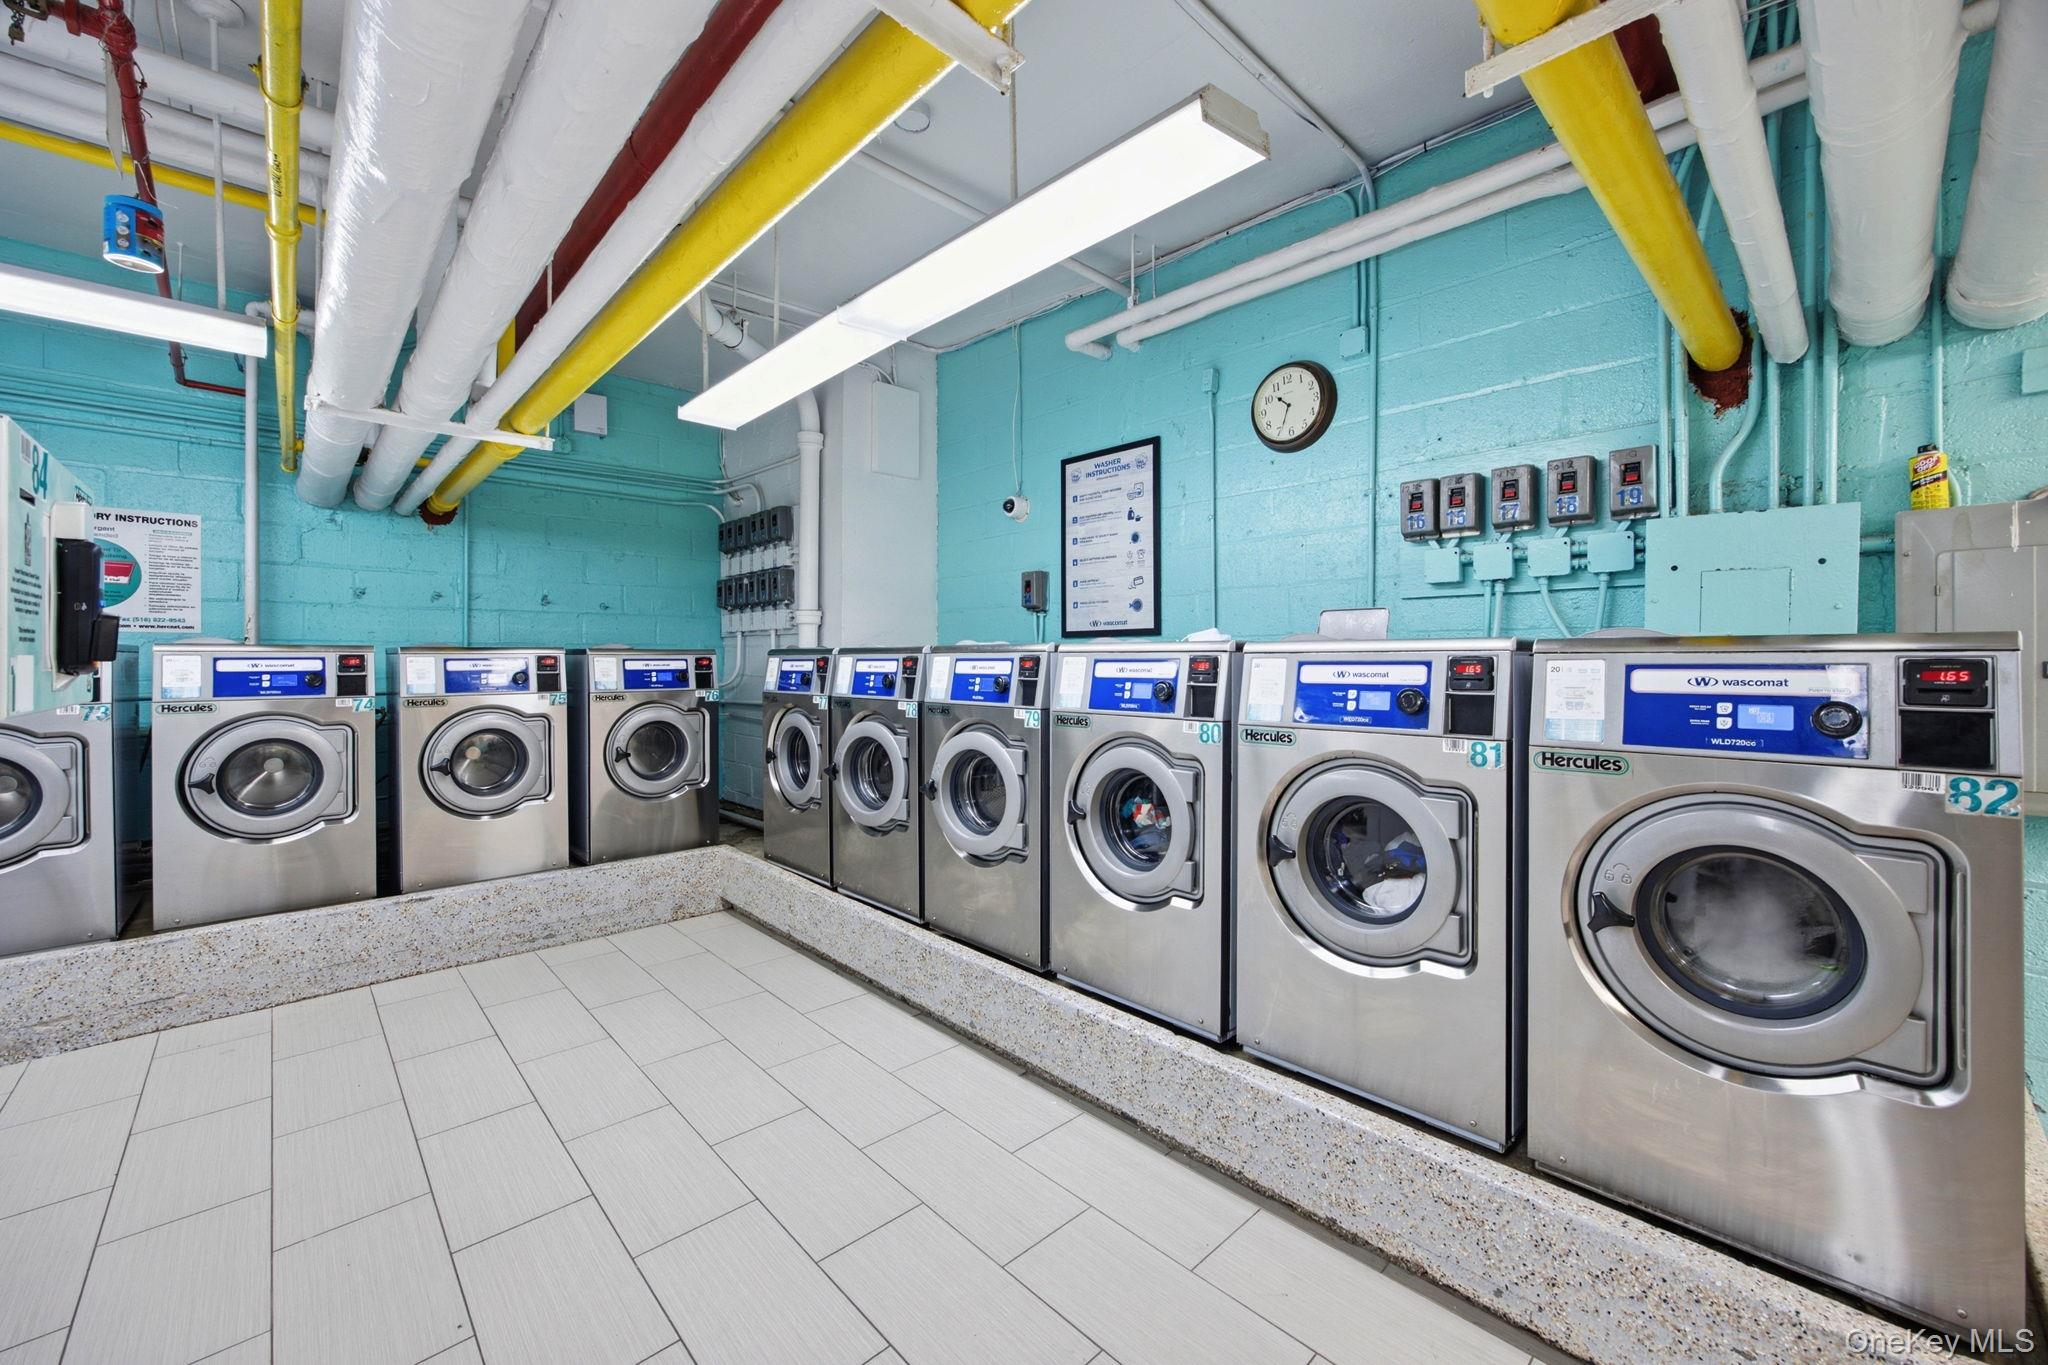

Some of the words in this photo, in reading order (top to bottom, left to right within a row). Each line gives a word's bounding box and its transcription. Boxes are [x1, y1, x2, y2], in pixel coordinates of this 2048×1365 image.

[1282, 373, 1293, 386] 12
[1299, 374, 1303, 383] 1
[1272, 382, 1280, 392] 11
[1308, 380, 1315, 391] 2
[1264, 395, 1274, 405] 10
[1313, 391, 1320, 402] 3
[1260, 409, 1267, 419] 9
[1309, 407, 1316, 416] 4
[1265, 420, 1272, 430] 8
[1301, 418, 1308, 429] 5
[1276, 426, 1282, 437] 7
[1288, 426, 1295, 437] 6
[1093, 457, 1122, 469] WASHER
[32, 444, 48, 499] 84
[1085, 463, 1132, 479] INSTRUCTIONS
[1616, 486, 1643, 507] 19
[1554, 495, 1578, 515] 18
[1446, 509, 1466, 526] 15
[1498, 502, 1520, 521] 17
[94, 512, 112, 521] RY
[115, 513, 199, 529] INSTRUCTIONS
[1406, 512, 1425, 530] 16
[1352, 670, 1390, 679] wascomat
[1722, 677, 1789, 688] wascomat
[406, 699, 446, 707] Hercules
[551, 694, 567, 706] 75
[595, 694, 625, 702] Hercules
[80, 704, 110, 721] 73
[161, 703, 213, 714] Hercules
[906, 703, 917, 717] 78
[1024, 710, 1040, 727] 79
[1056, 714, 1089, 727] Hercules
[1199, 723, 1222, 744] 80
[1245, 729, 1293, 744] Hercules
[1470, 741, 1502, 768] 81
[1541, 751, 1623, 772] Hercules
[1947, 776, 2020, 817] 82
